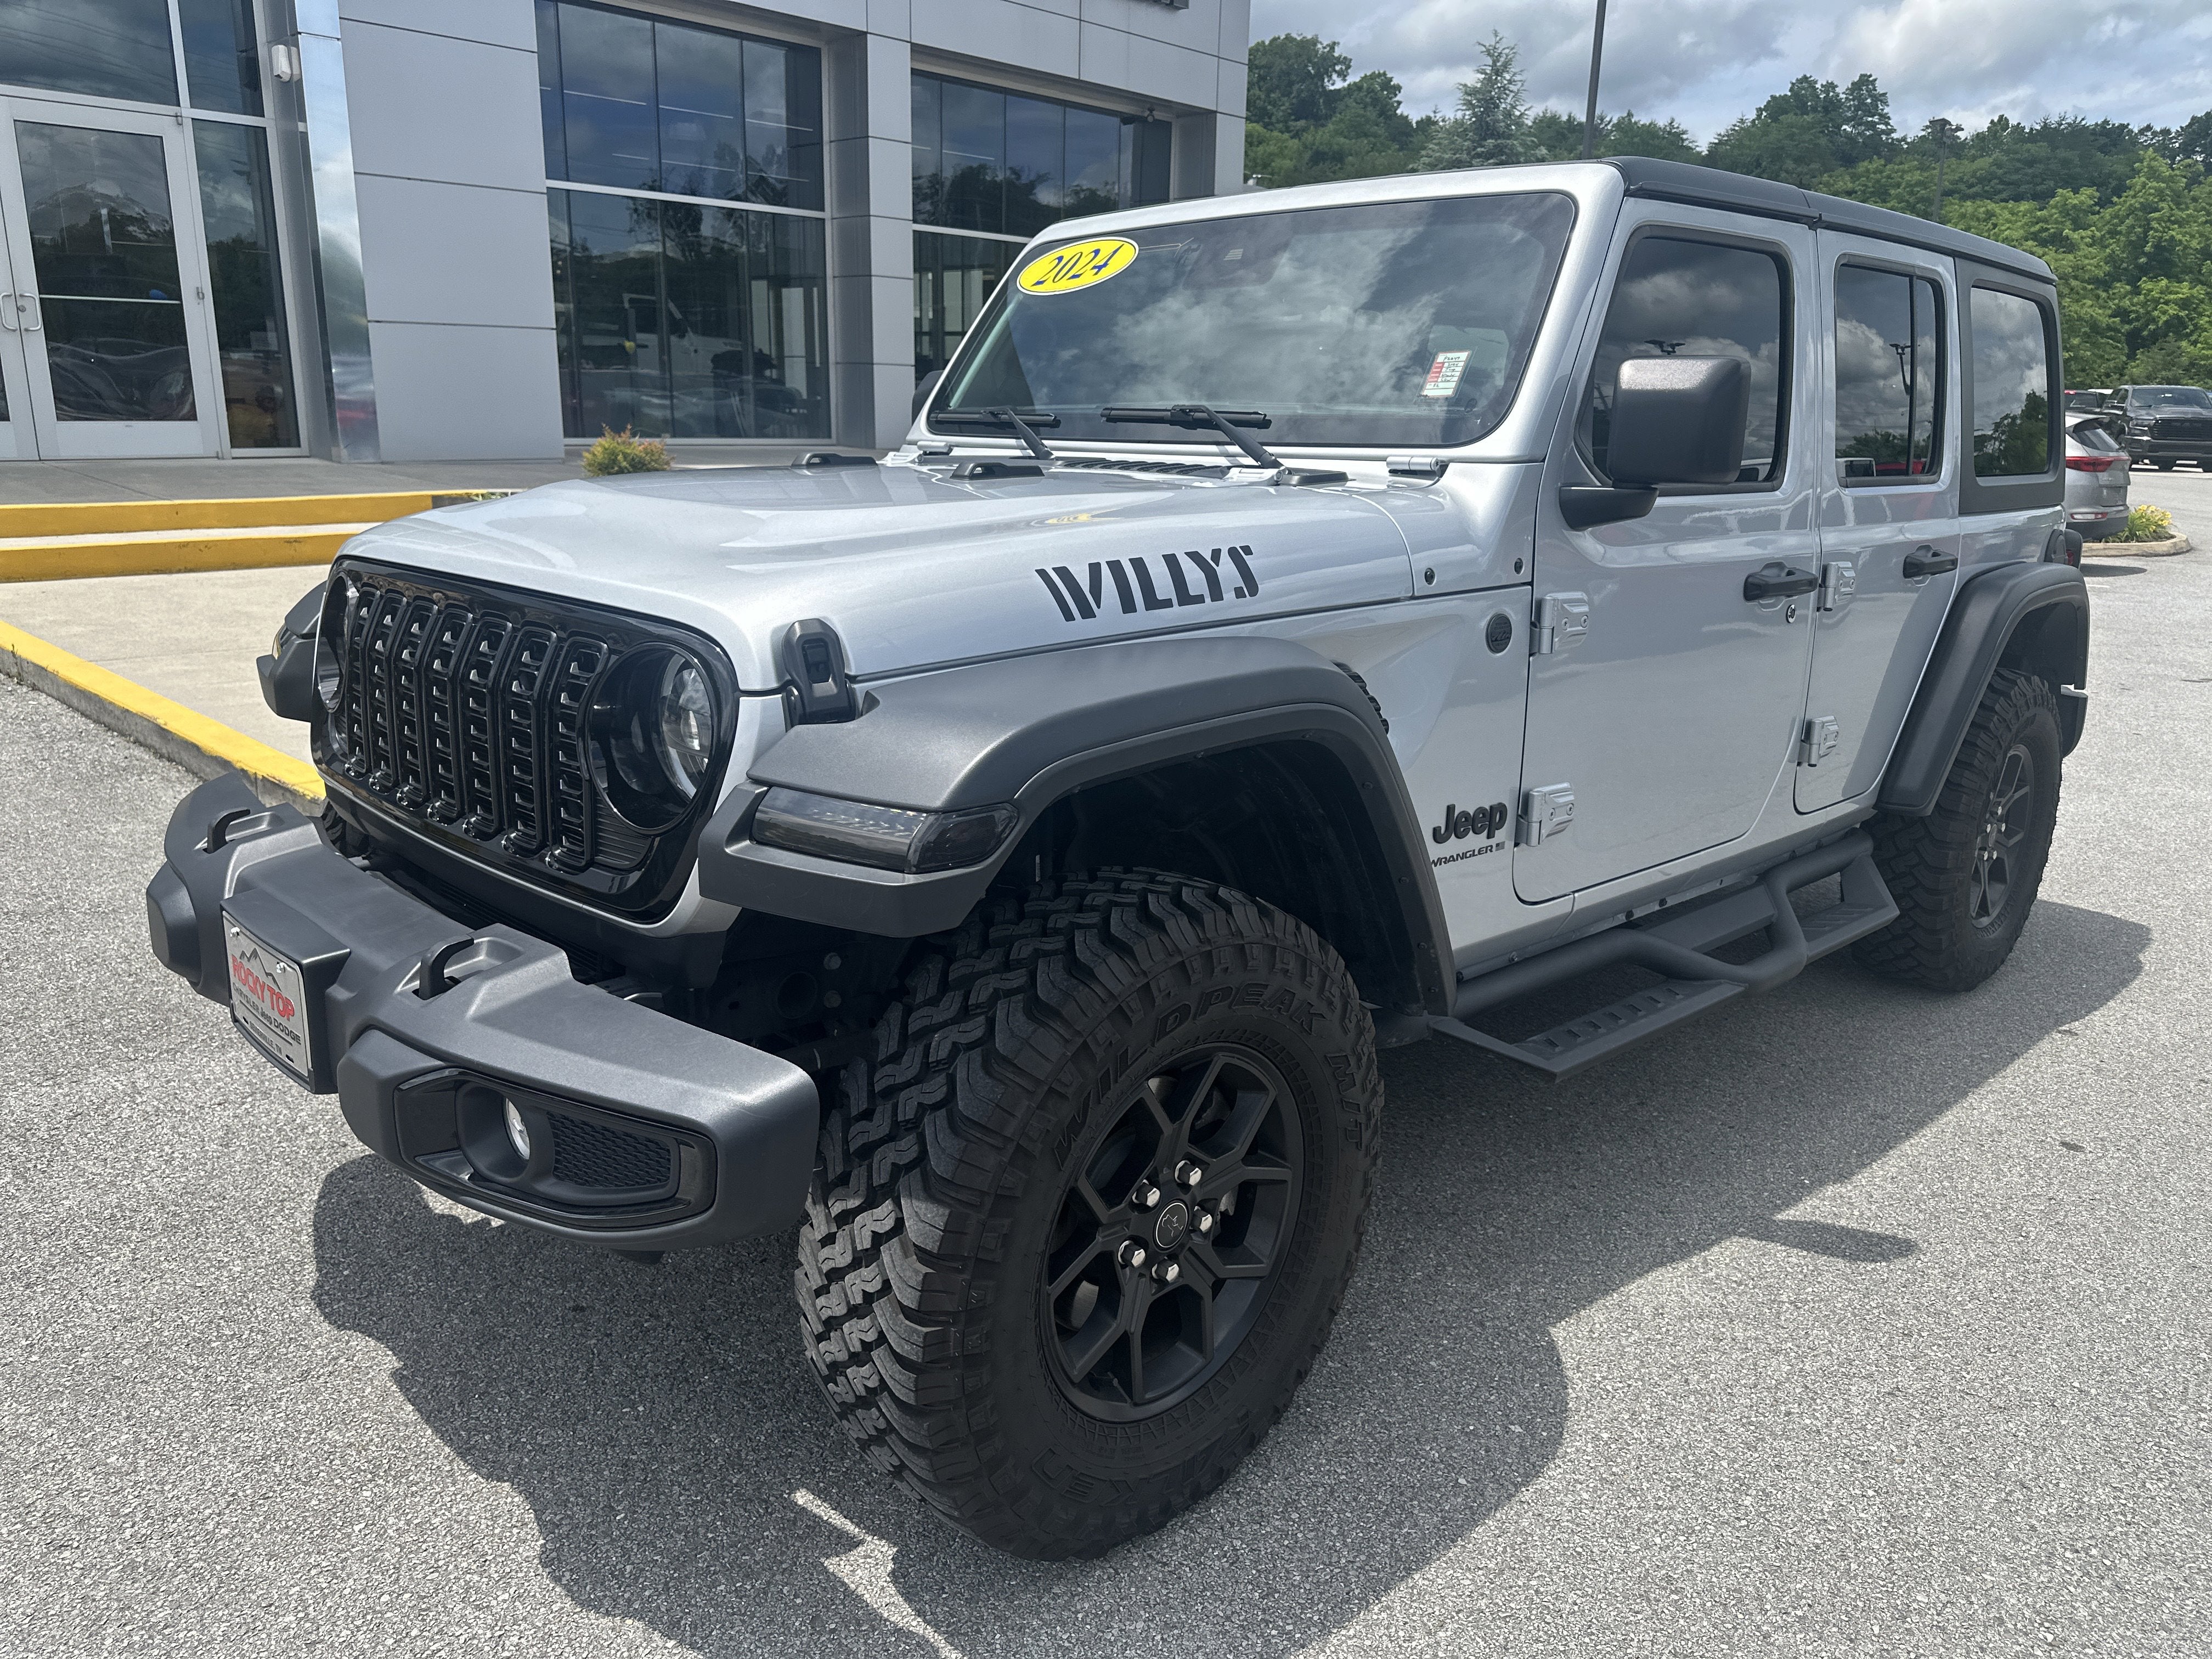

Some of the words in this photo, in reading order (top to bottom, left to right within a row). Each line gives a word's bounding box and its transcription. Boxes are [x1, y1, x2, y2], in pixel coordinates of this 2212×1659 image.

[1030, 243, 1125, 287] 2024
[1035, 545, 1259, 622] WILLYS
[1432, 802, 1508, 844] Jeep
[1431, 844, 1493, 867] WRANGLER
[232, 953, 266, 1003] ROCKY
[267, 984, 295, 1022] TOP
[233, 981, 259, 1015] CHRYSLER
[273, 1017, 302, 1045] DODGE
